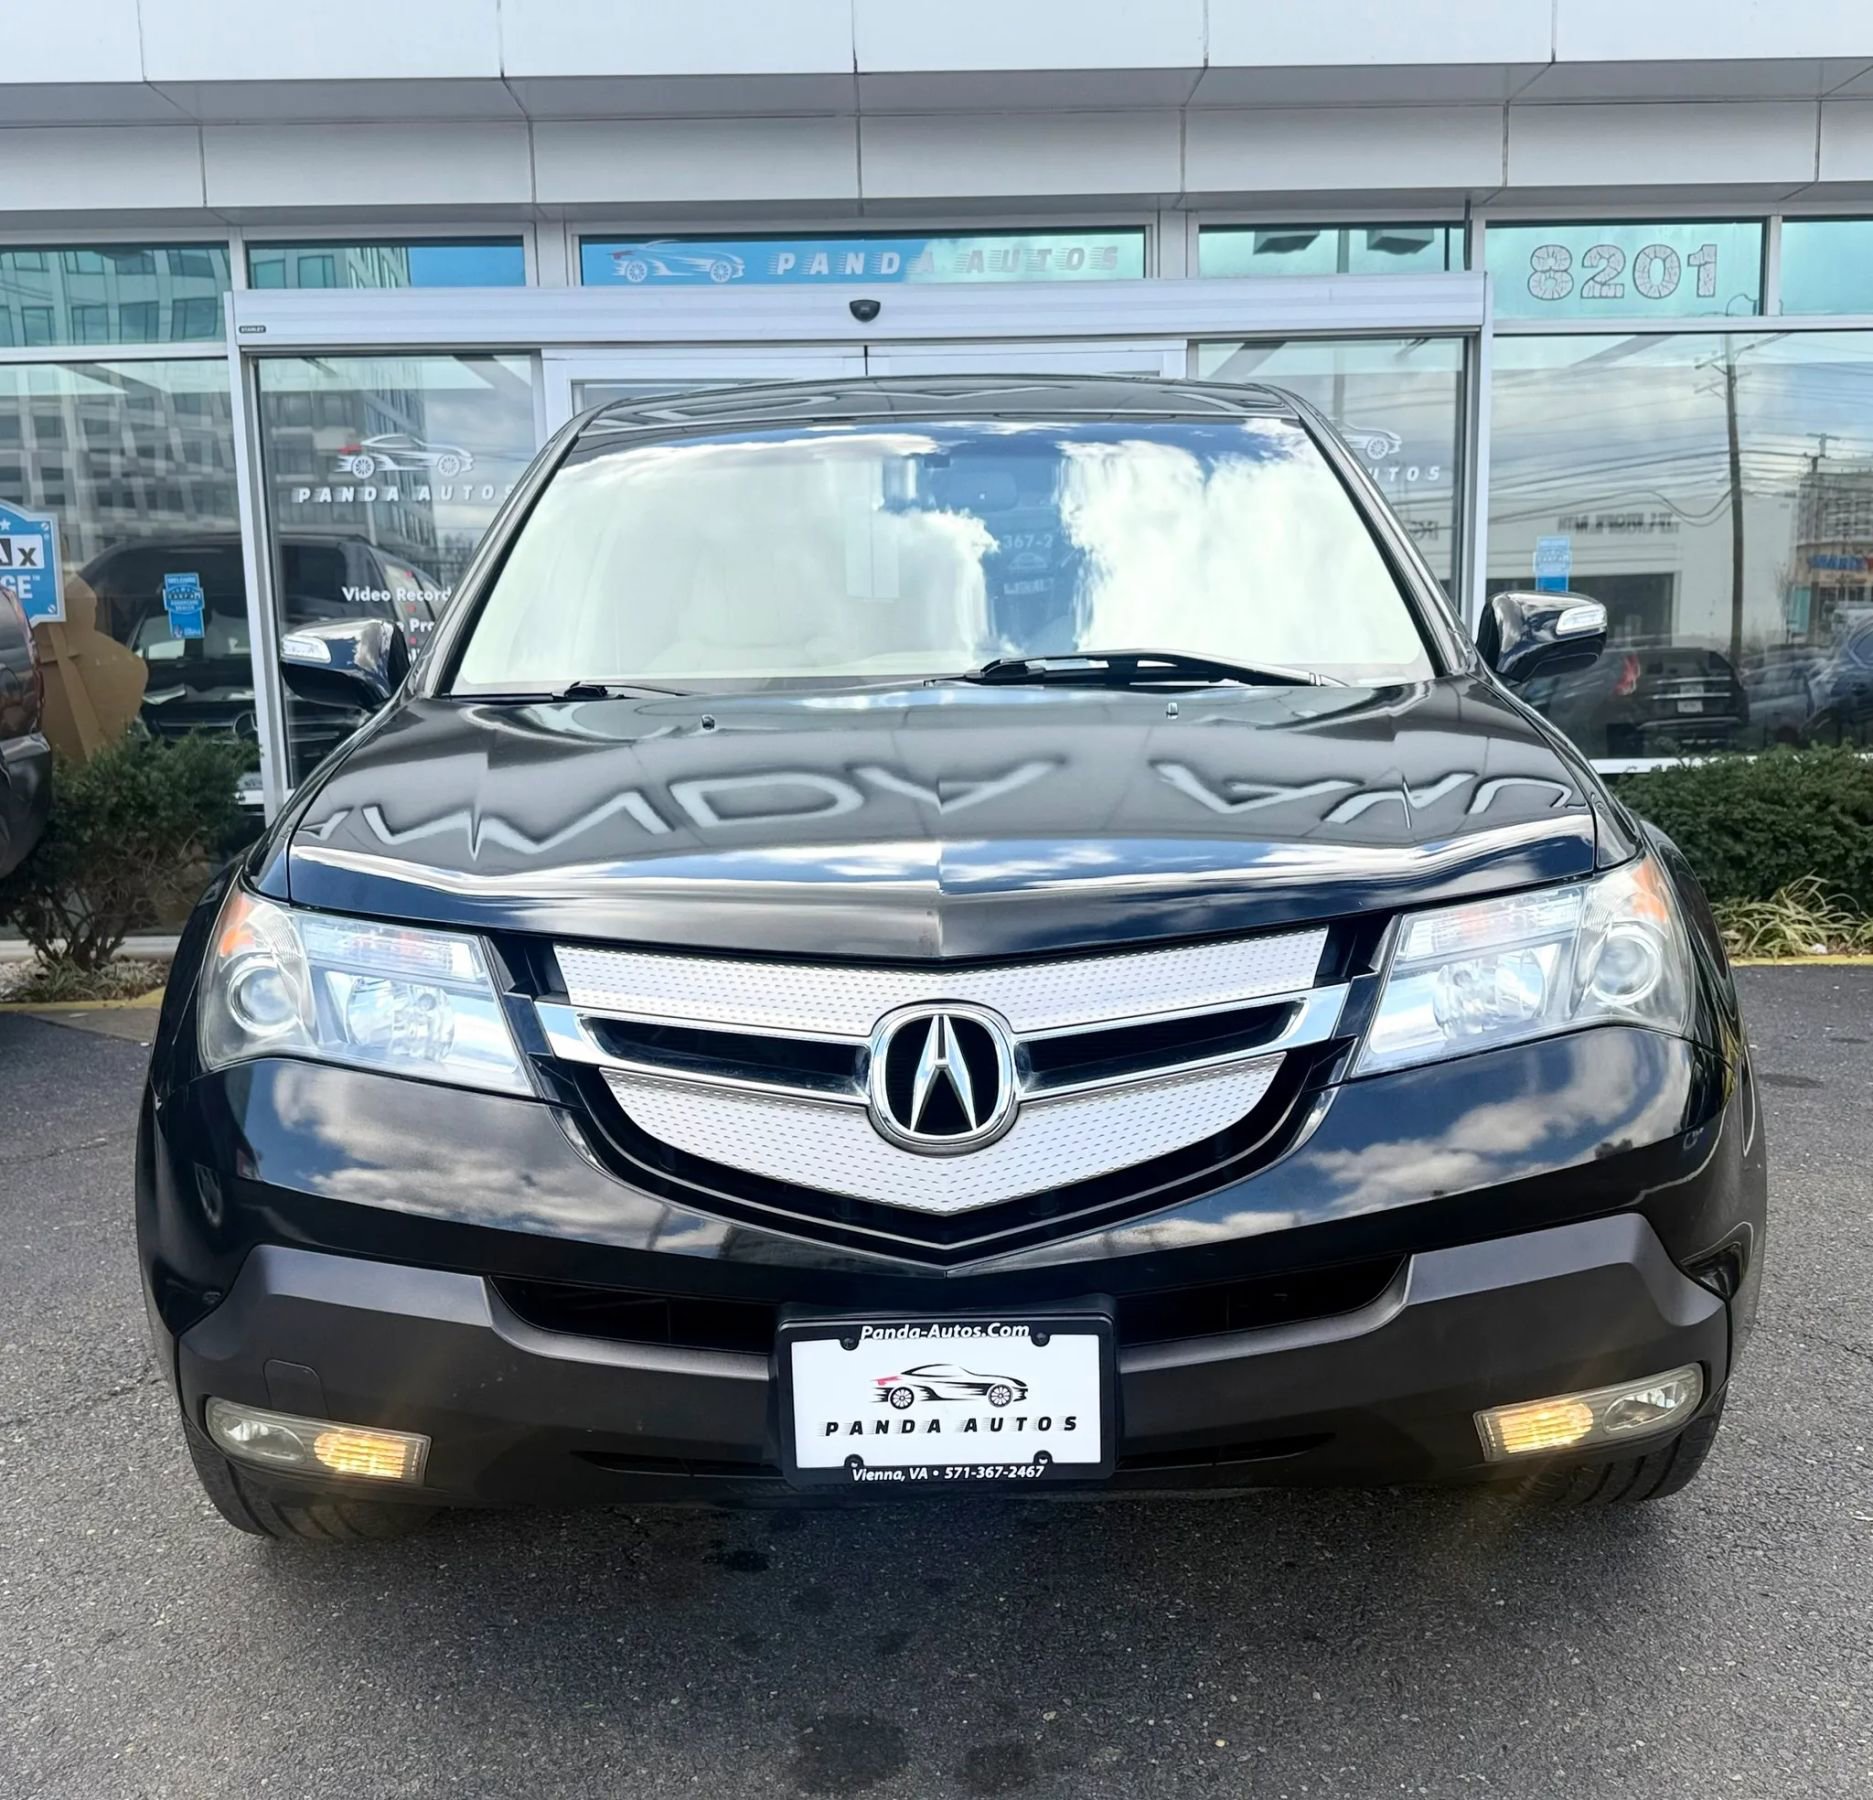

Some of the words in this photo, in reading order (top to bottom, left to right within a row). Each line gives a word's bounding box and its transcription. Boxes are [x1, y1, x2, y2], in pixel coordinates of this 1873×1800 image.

[774, 251, 936, 276] PANDA
[962, 246, 1120, 274] AUTOS
[1527, 244, 1718, 301] 8201
[297, 486, 400, 503] PANDA
[341, 586, 391, 602] Video
[396, 586, 452, 602] Record
[860, 1322, 1030, 1340] Panda-Autos.Com
[824, 1418, 941, 1436] PANDA
[963, 1416, 1077, 1433] AUTOS
[852, 1468, 906, 1482] Vienna,
[908, 1467, 929, 1480] VA
[944, 1465, 1045, 1479] 571-367-2467
